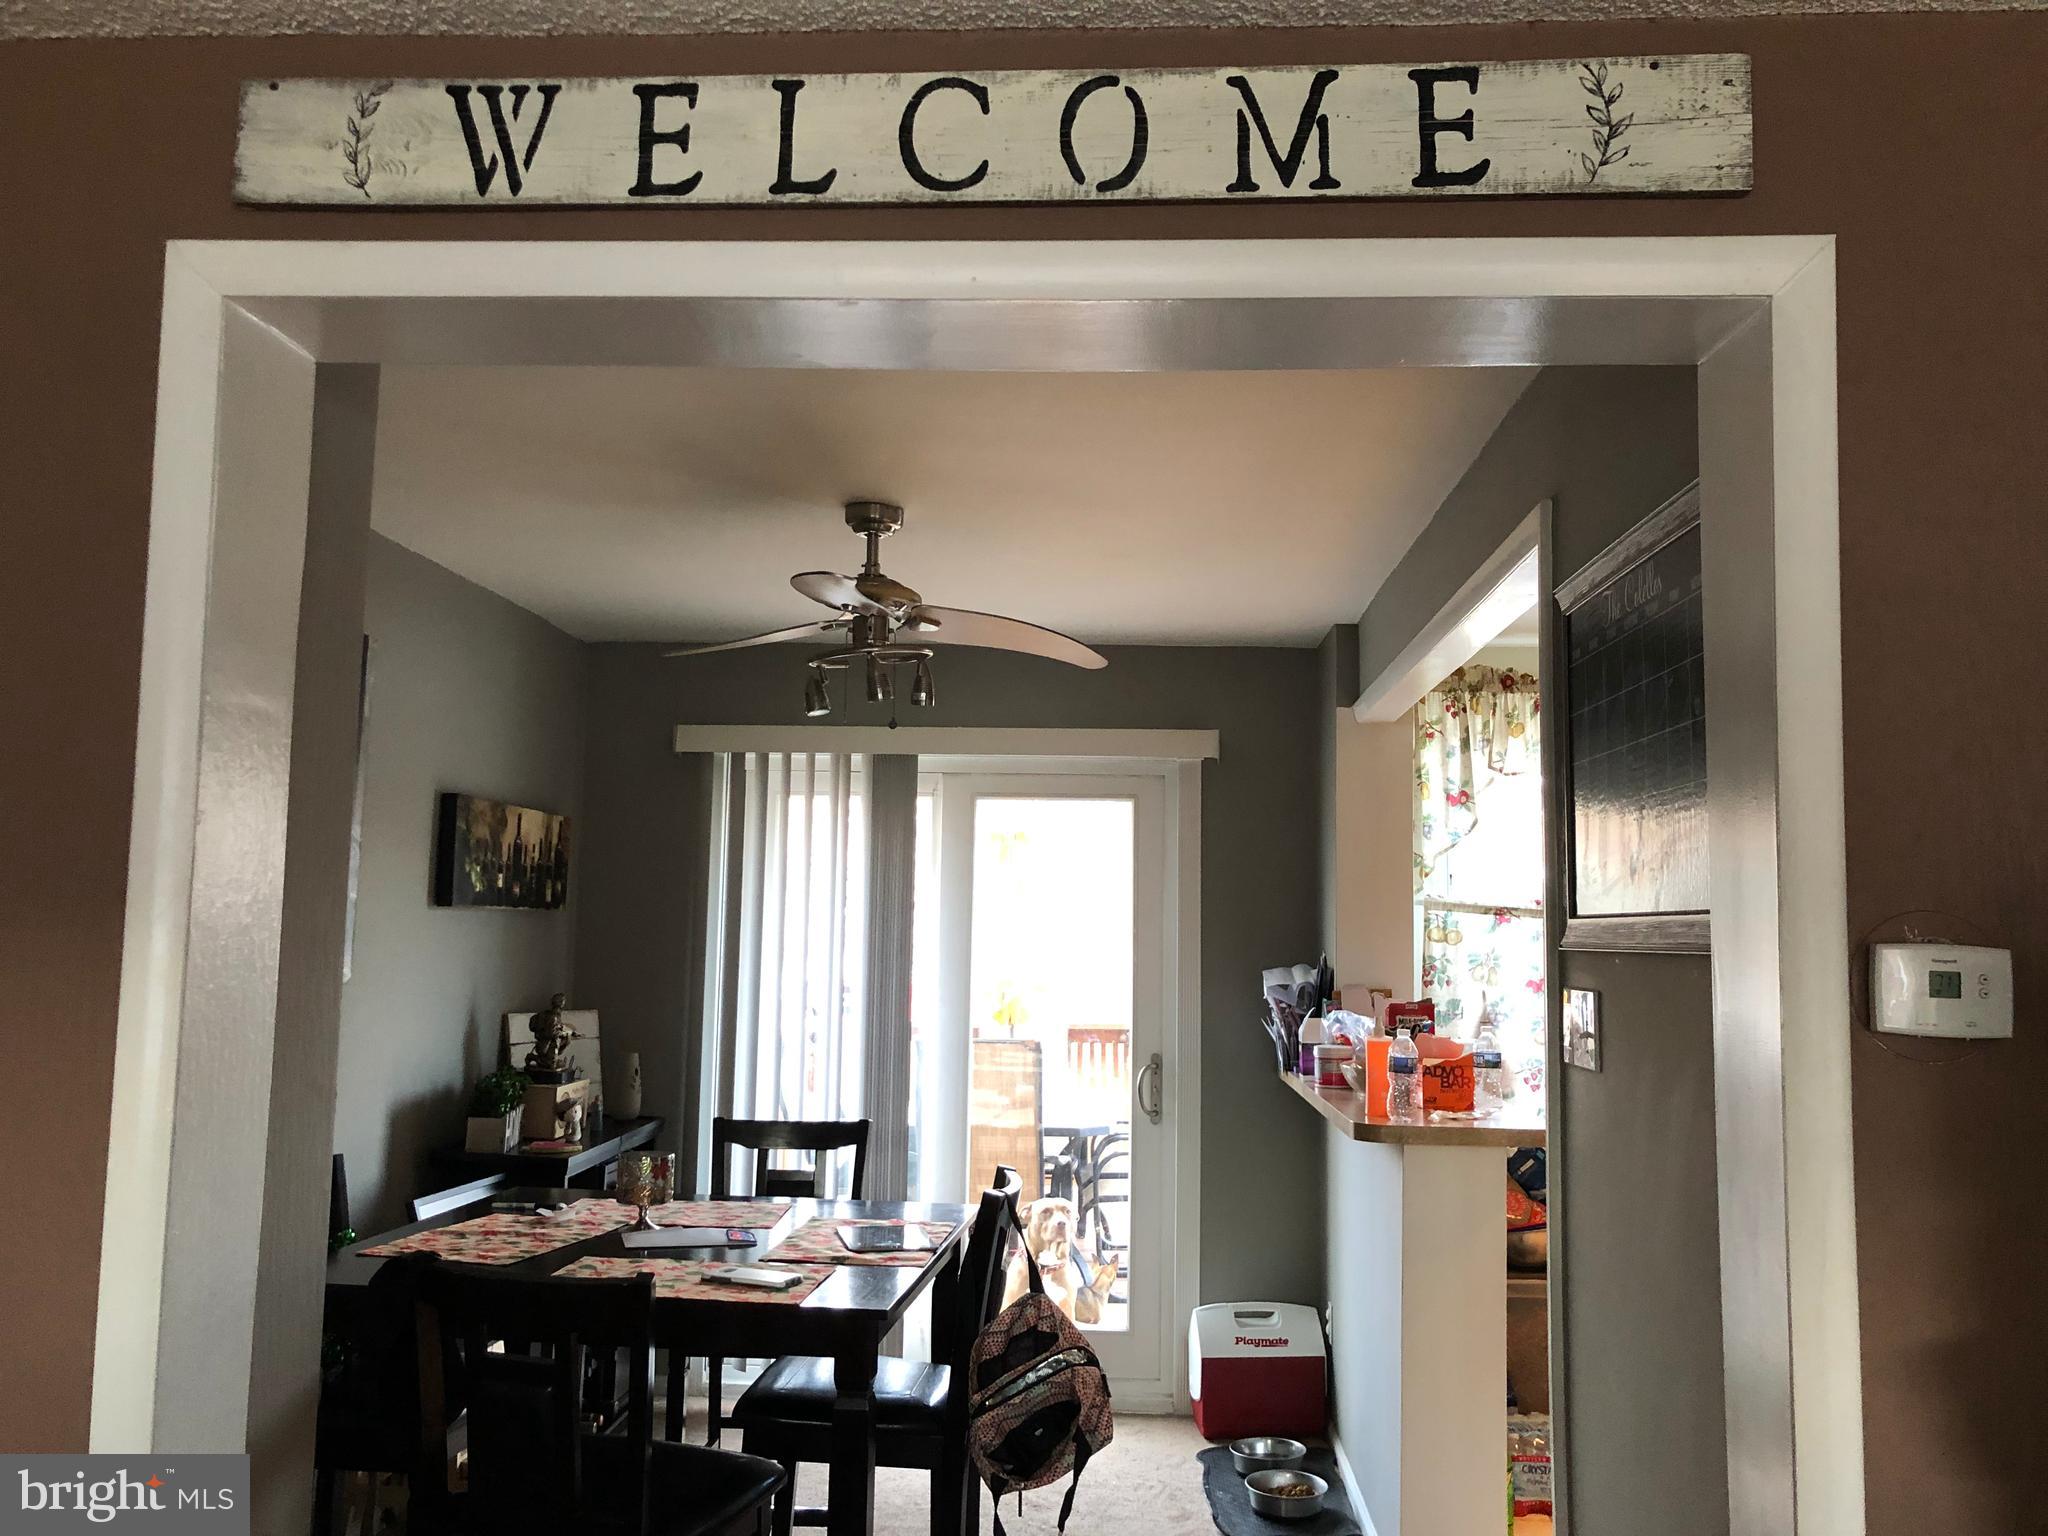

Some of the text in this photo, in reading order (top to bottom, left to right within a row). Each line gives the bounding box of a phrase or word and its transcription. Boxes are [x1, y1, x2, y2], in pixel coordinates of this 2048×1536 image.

[444, 66, 1491, 197] WELCOME
[1440, 1076, 1471, 1088] BAR
[1234, 1336, 1289, 1347] Playmate
